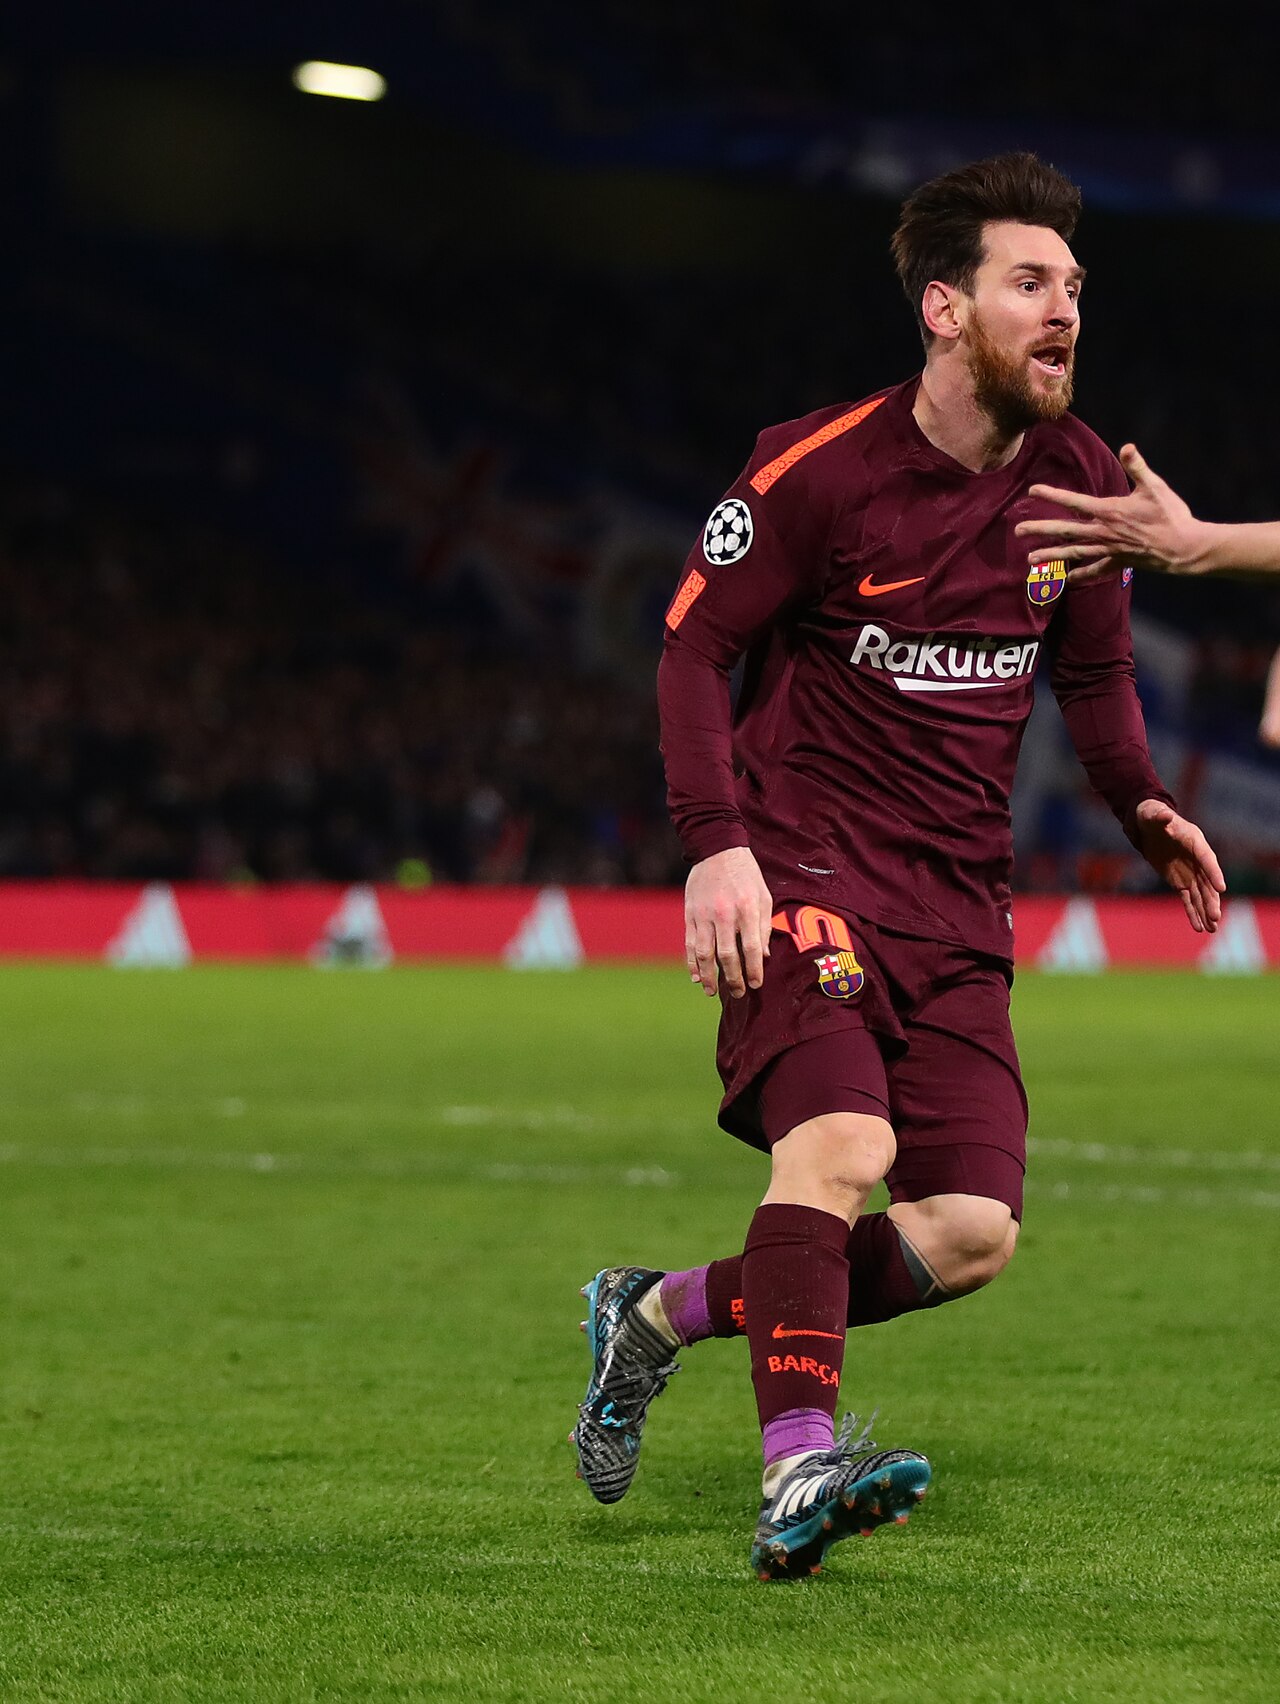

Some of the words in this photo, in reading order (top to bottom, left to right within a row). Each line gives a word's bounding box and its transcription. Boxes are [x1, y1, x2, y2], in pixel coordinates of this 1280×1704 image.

[1038, 573, 1055, 582] FCB
[850, 624, 1039, 678] Rakuten
[831, 970, 850, 980] FCB
[767, 1353, 839, 1388] BARÇA
